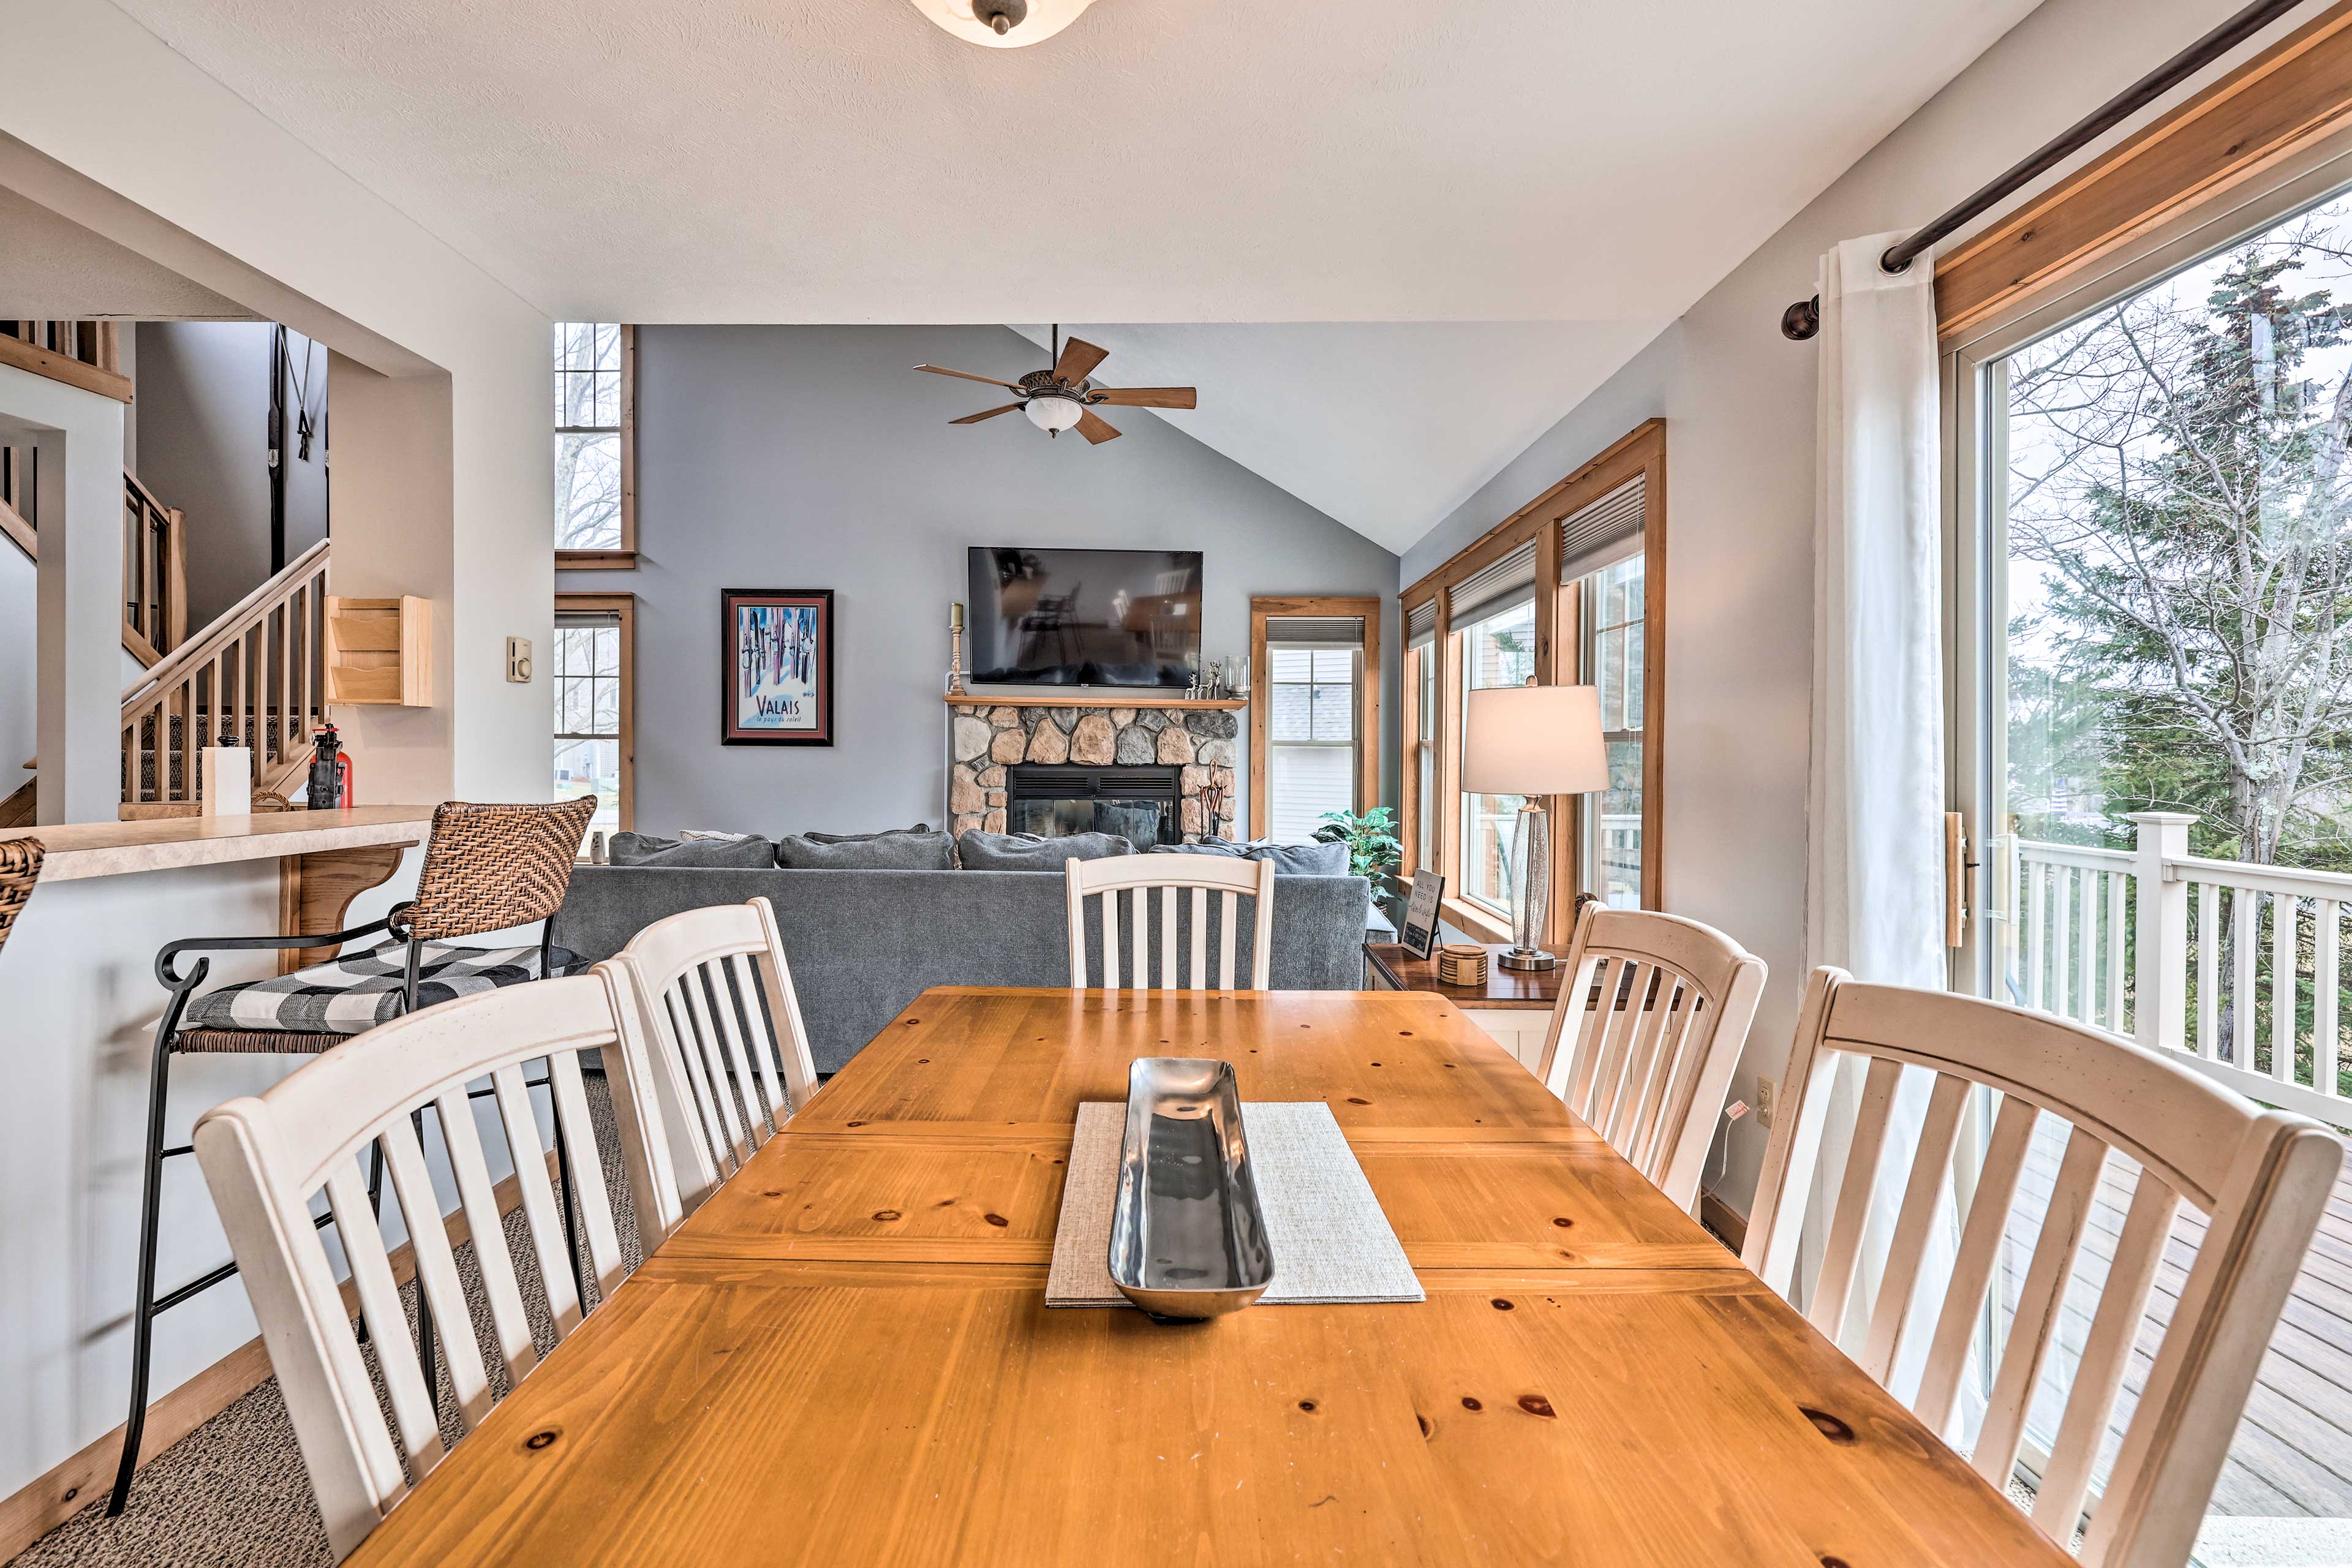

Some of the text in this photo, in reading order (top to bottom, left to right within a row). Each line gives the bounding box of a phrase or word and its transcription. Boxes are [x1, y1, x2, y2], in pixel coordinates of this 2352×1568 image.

[756, 695, 800, 717] VALAIS
[1427, 884, 1436, 892] YOU
[1414, 891, 1427, 900] NEED
